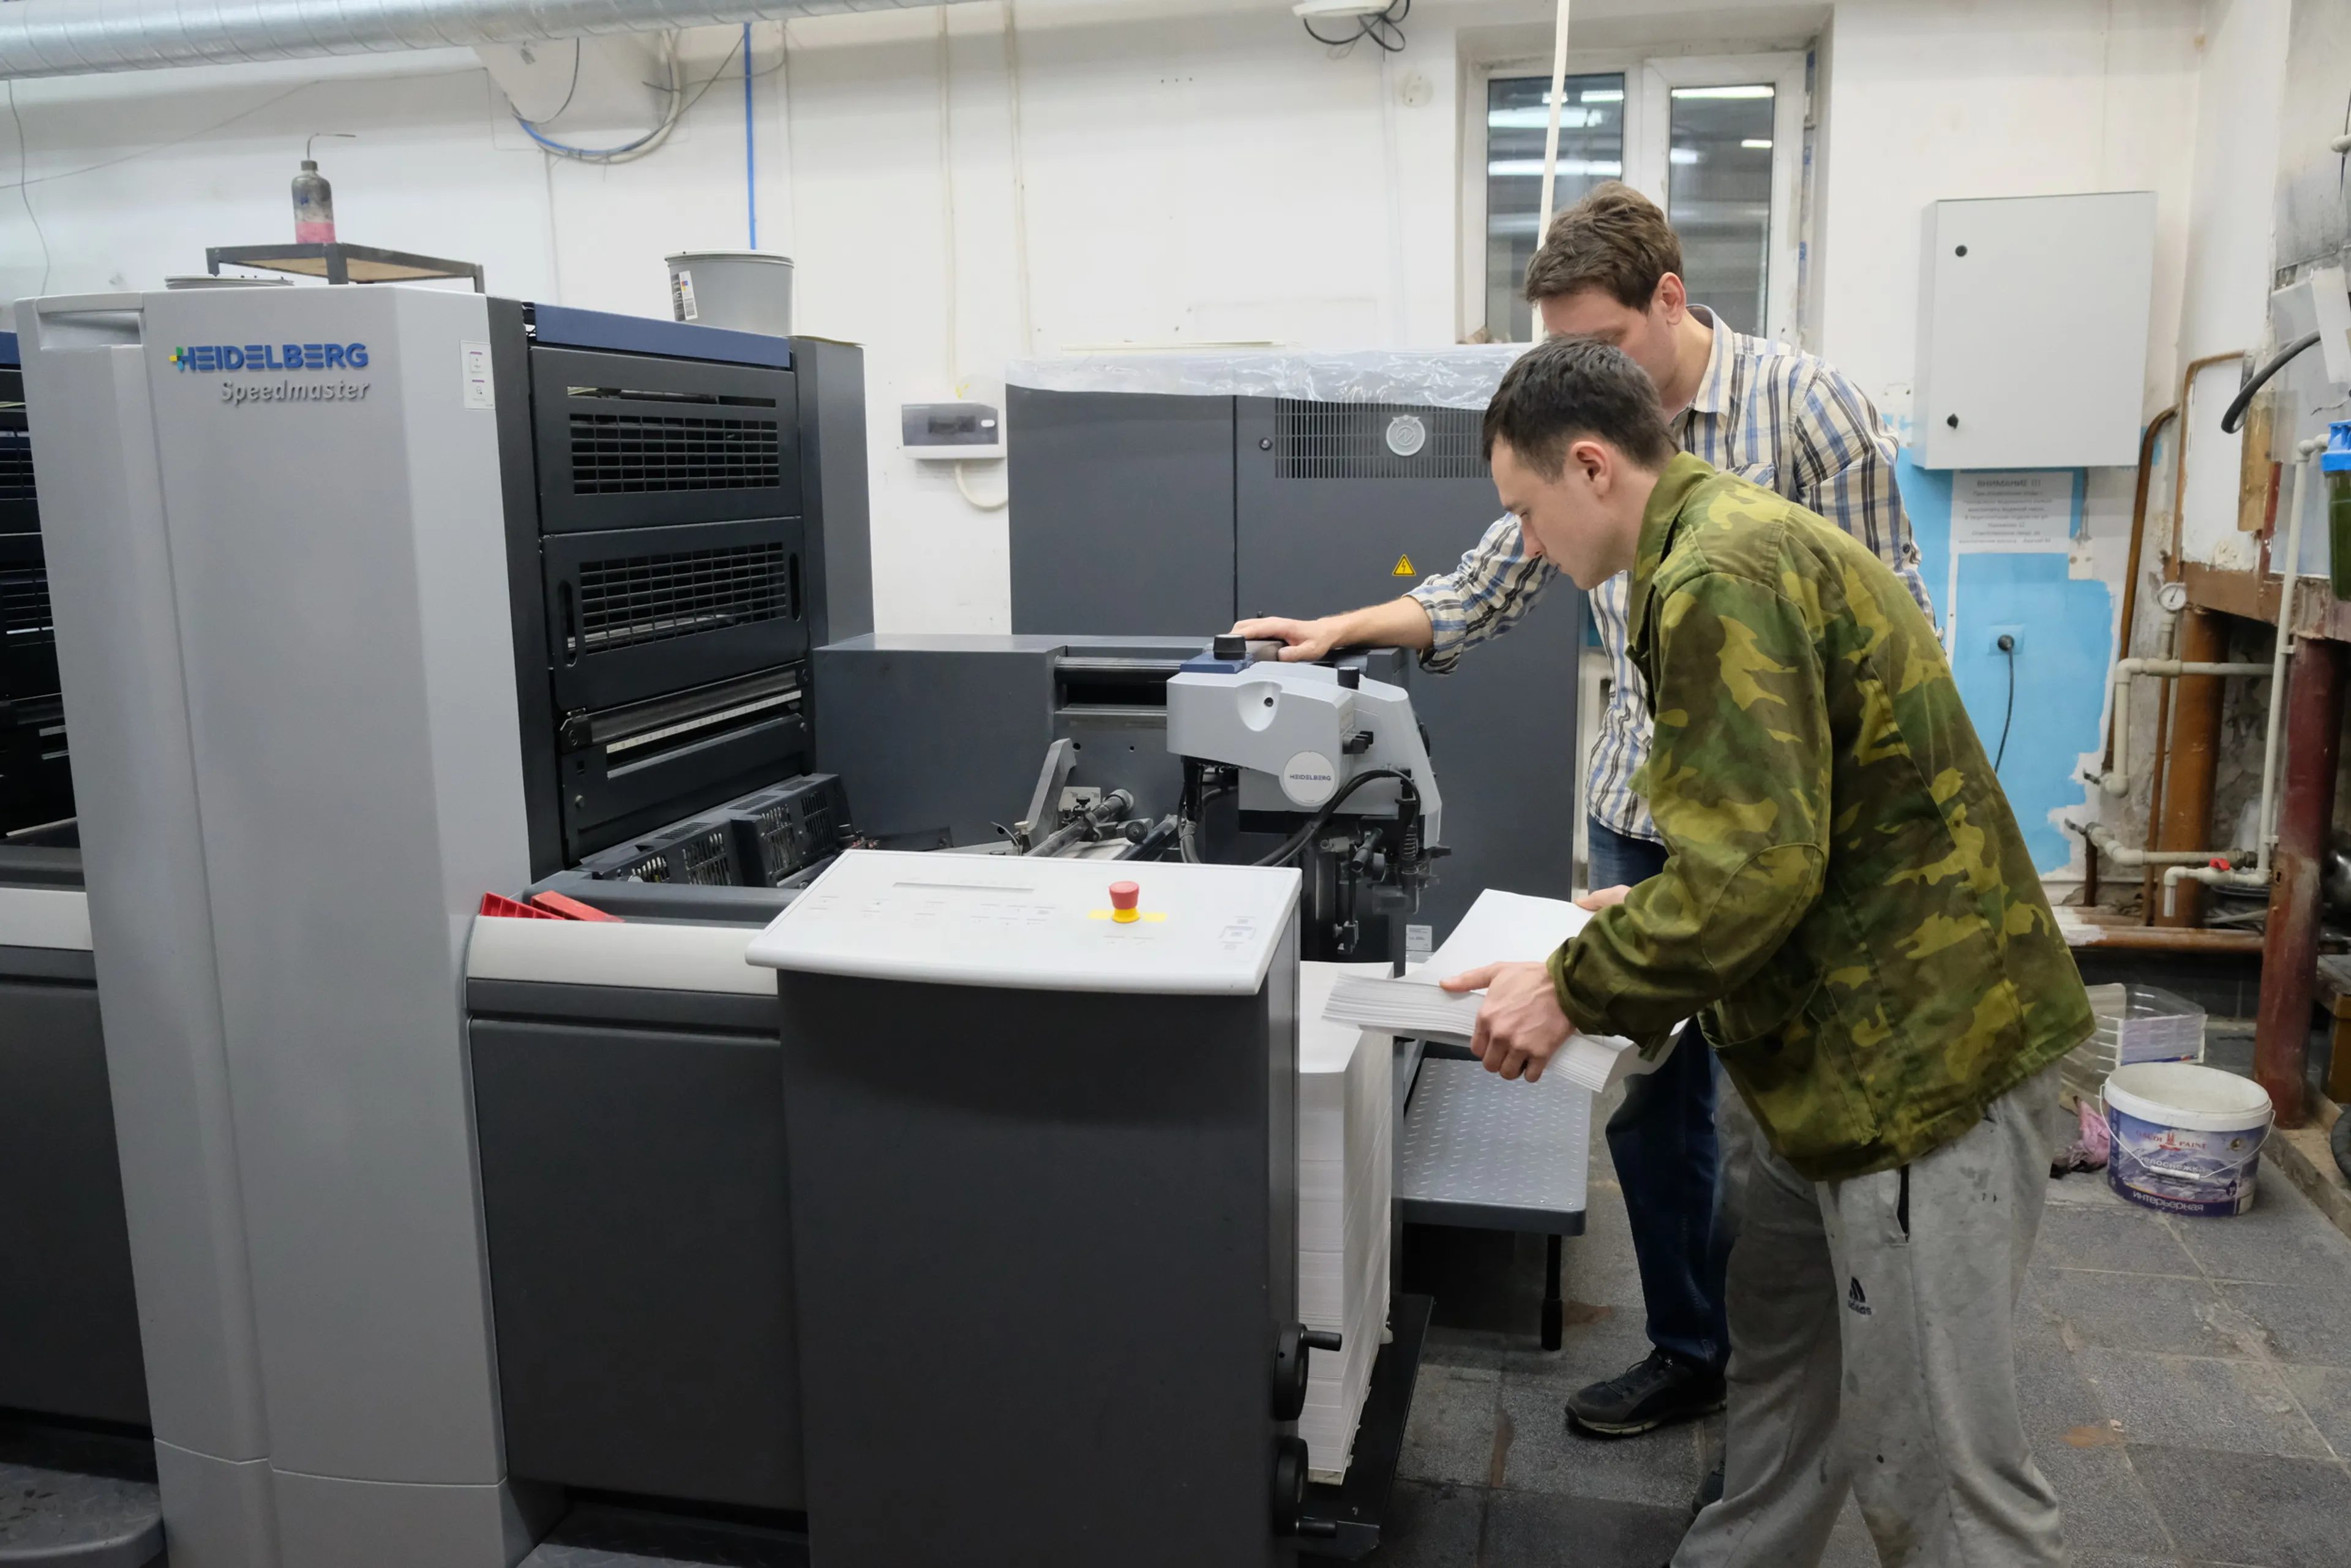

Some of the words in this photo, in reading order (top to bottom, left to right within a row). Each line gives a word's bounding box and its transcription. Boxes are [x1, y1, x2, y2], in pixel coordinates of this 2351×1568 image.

[170, 342, 369, 371] HEIDELBERG
[221, 380, 370, 407] Speedmaster
[2132, 1190, 2204, 1212] интерьерная
